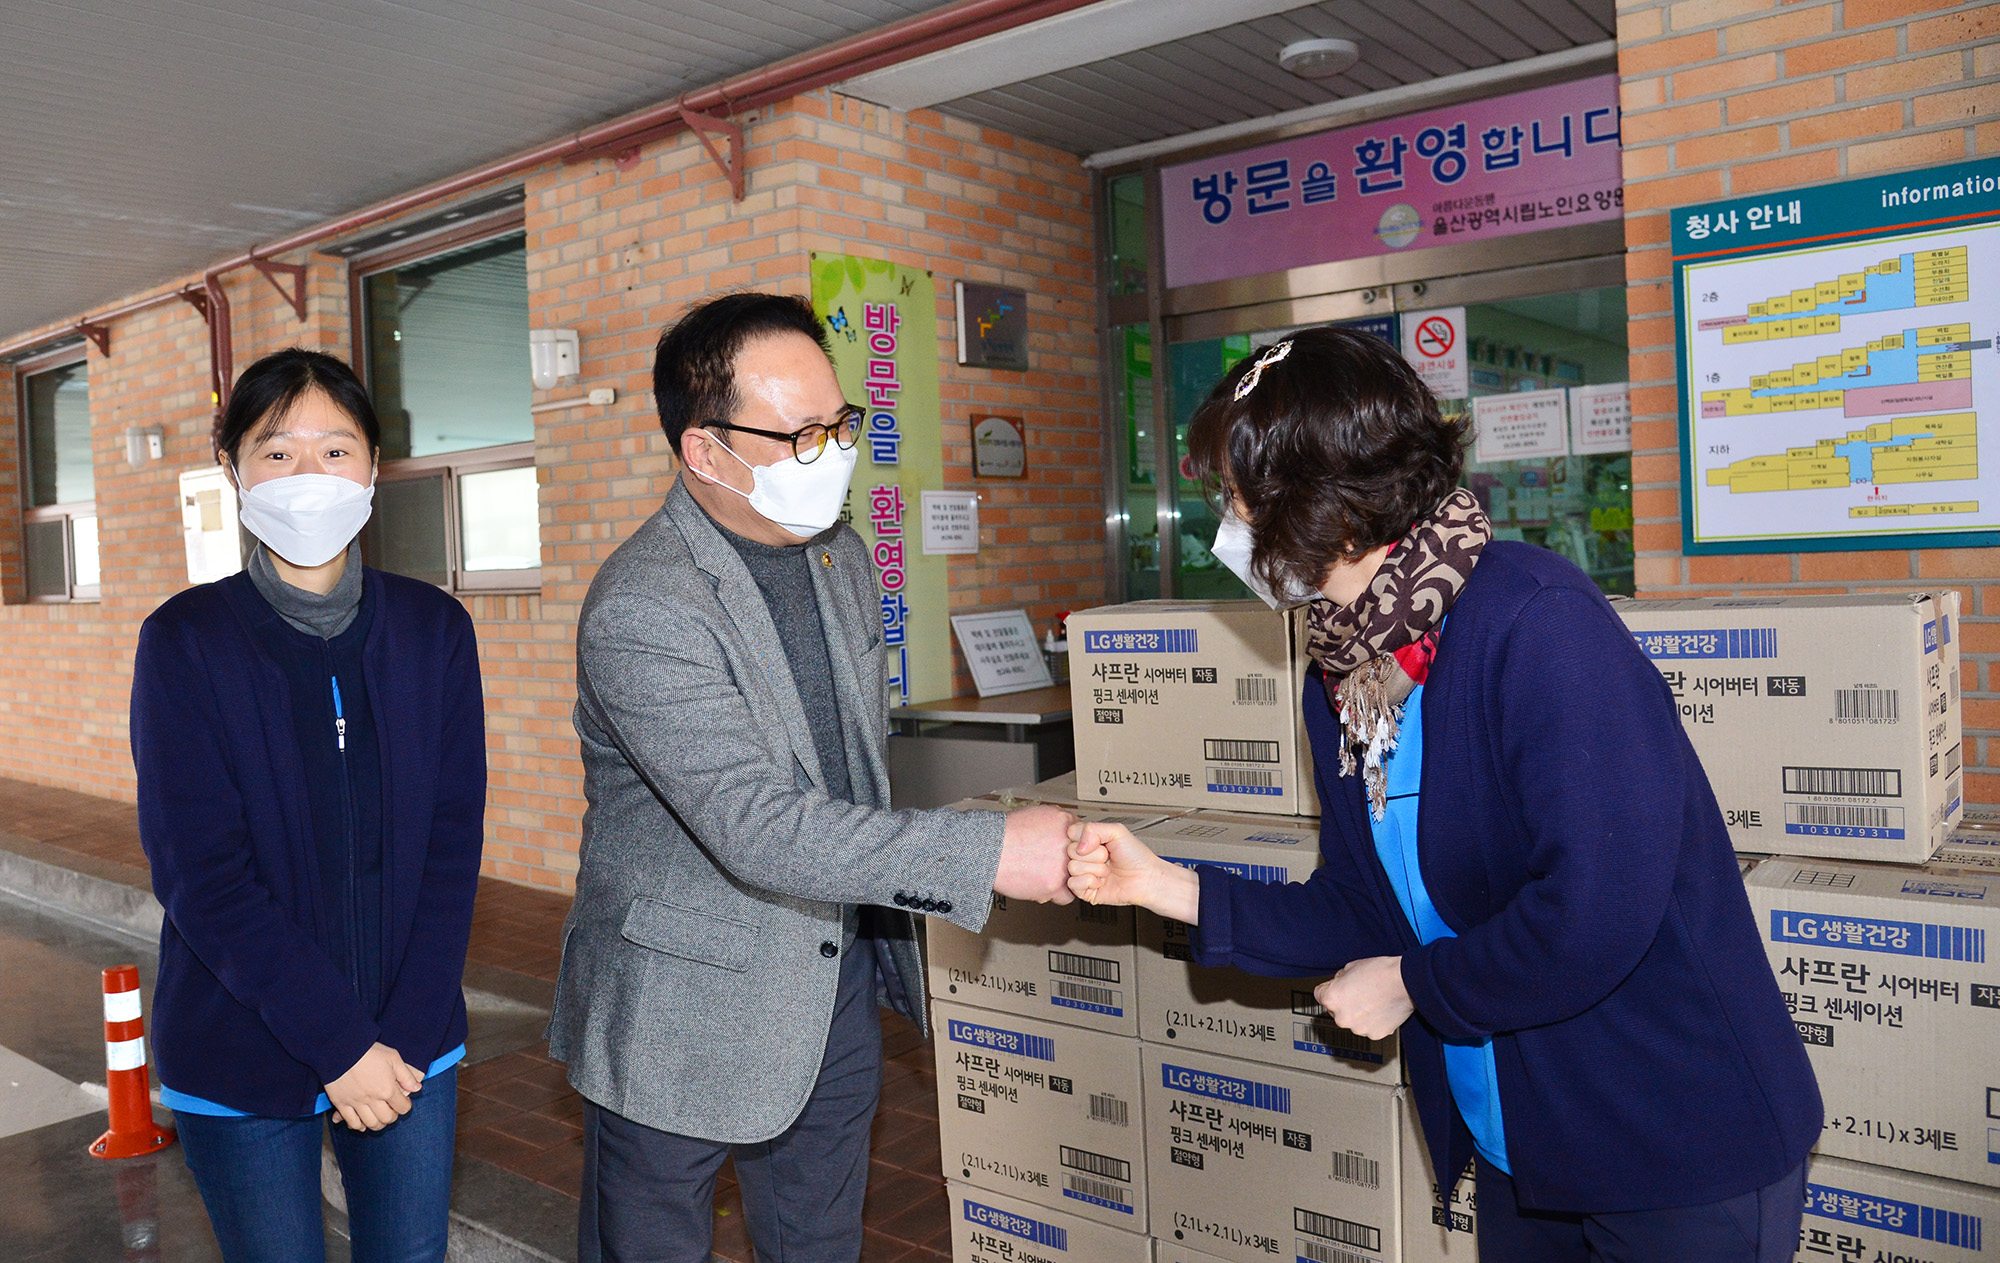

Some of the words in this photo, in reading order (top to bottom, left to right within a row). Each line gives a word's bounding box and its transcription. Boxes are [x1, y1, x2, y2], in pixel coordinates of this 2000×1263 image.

[1191, 158, 1337, 225] 방문을
[1686, 209, 1739, 240] 청사
[1747, 200, 1802, 231] 안내
[1930, 294, 1954, 303] 카네이션
[1418, 360, 1455, 373] 금연시설
[864, 302, 902, 465] 방문을
[1709, 444, 1730, 456] 지하
[868, 484, 909, 706] 환영합니
[1090, 633, 1160, 650] LG생활건강
[1633, 634, 1718, 655] 생활건강
[1091, 662, 1140, 684] 샤프란
[1143, 667, 1187, 684] 시어버터
[1195, 668, 1214, 682] 자동
[1093, 688, 1114, 705] 핑크
[1117, 688, 1160, 705] 센세이션
[1692, 676, 1759, 697] 시어버터
[1772, 677, 1801, 695] 자동
[1095, 709, 1121, 723] 절약형
[1676, 702, 1714, 724] 이션
[1216, 785, 1274, 795] 10302931
[1799, 825, 1891, 838] 10302931
[1782, 916, 1911, 949] LG생활건강
[1779, 957, 1870, 995] 샤프란
[1878, 974, 1960, 1004] 시어버터
[1059, 998, 1115, 1015] 10302931
[1824, 997, 1903, 1029] 센세이션
[954, 1023, 1019, 1050] LG생활건강
[1795, 1022, 1828, 1044] 약형
[955, 1052, 1001, 1080] 샤프란
[1004, 1066, 1045, 1089] 시어버터
[1052, 1076, 1070, 1092] 자동
[1169, 1069, 1247, 1099] LG생활건강
[957, 1075, 976, 1092] 핑크
[978, 1079, 1019, 1104] 센세이션
[959, 1095, 983, 1112] 절약형
[1169, 1100, 1224, 1132] 샤프란
[1228, 1118, 1278, 1144] 시어버터
[1286, 1131, 1309, 1149] 자동
[1170, 1125, 1194, 1144] 핑크
[1196, 1133, 1245, 1160] 센세이션
[1172, 1148, 1201, 1167] 절약형
[1070, 1191, 1127, 1212] 10302931
[1804, 1189, 1908, 1228] 생활건강
[969, 1203, 1033, 1236] LG생활건강
[970, 1231, 1014, 1260] 샤프란
[1799, 1229, 1867, 1263] 프란
